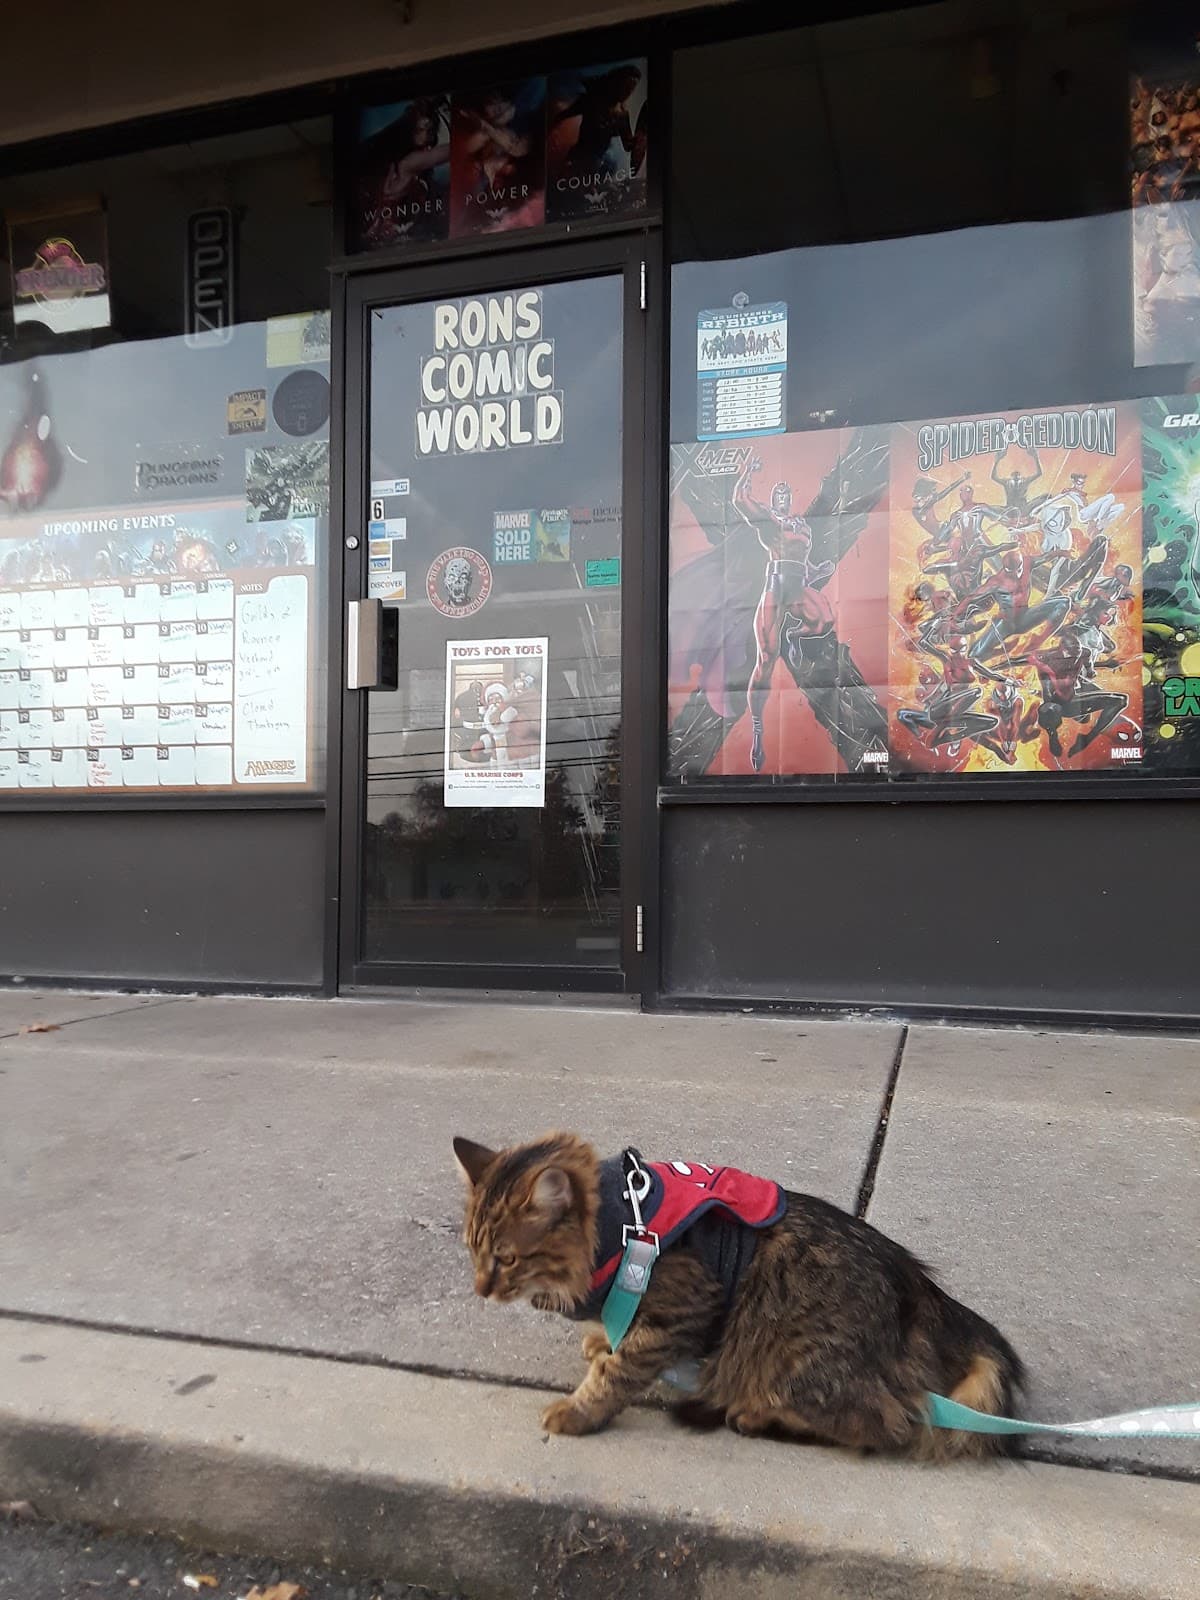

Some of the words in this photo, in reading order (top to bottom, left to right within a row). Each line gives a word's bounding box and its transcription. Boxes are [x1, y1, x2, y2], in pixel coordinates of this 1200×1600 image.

[556, 167, 638, 191] COURAGE
[465, 184, 529, 206] POWER
[363, 199, 443, 222] WONDER
[195, 216, 224, 341] OPEN
[435, 292, 541, 350] RONS
[702, 312, 784, 329] REBIRTH
[422, 342, 552, 403] COMIC
[417, 395, 561, 454] WORLD
[1163, 413, 1200, 428] GR
[138, 459, 220, 474] DUNGEONS
[710, 466, 737, 474] BLACK
[373, 501, 382, 520] 6
[44, 518, 119, 536] UPCOMING
[123, 514, 176, 530] EVENTS
[496, 512, 530, 529] MARVEL
[495, 529, 531, 546] SOLD
[495, 545, 531, 562] HERE
[240, 583, 264, 593] NOTES
[370, 580, 403, 589] DISCOVER
[199, 623, 207, 634] 10
[452, 647, 481, 657] TOYS
[484, 646, 511, 656] FOR
[515, 644, 543, 655] TOTS
[125, 667, 134, 678] 15
[159, 666, 168, 677] 16
[197, 664, 206, 675] 17
[54, 710, 64, 721] 20
[123, 708, 133, 718] 22
[159, 708, 169, 718] 23
[195, 705, 206, 716] 24
[122, 749, 133, 760] 29
[158, 749, 169, 760] 30
[863, 752, 889, 763] MARVE
[1111, 747, 1143, 759] MARVEL
